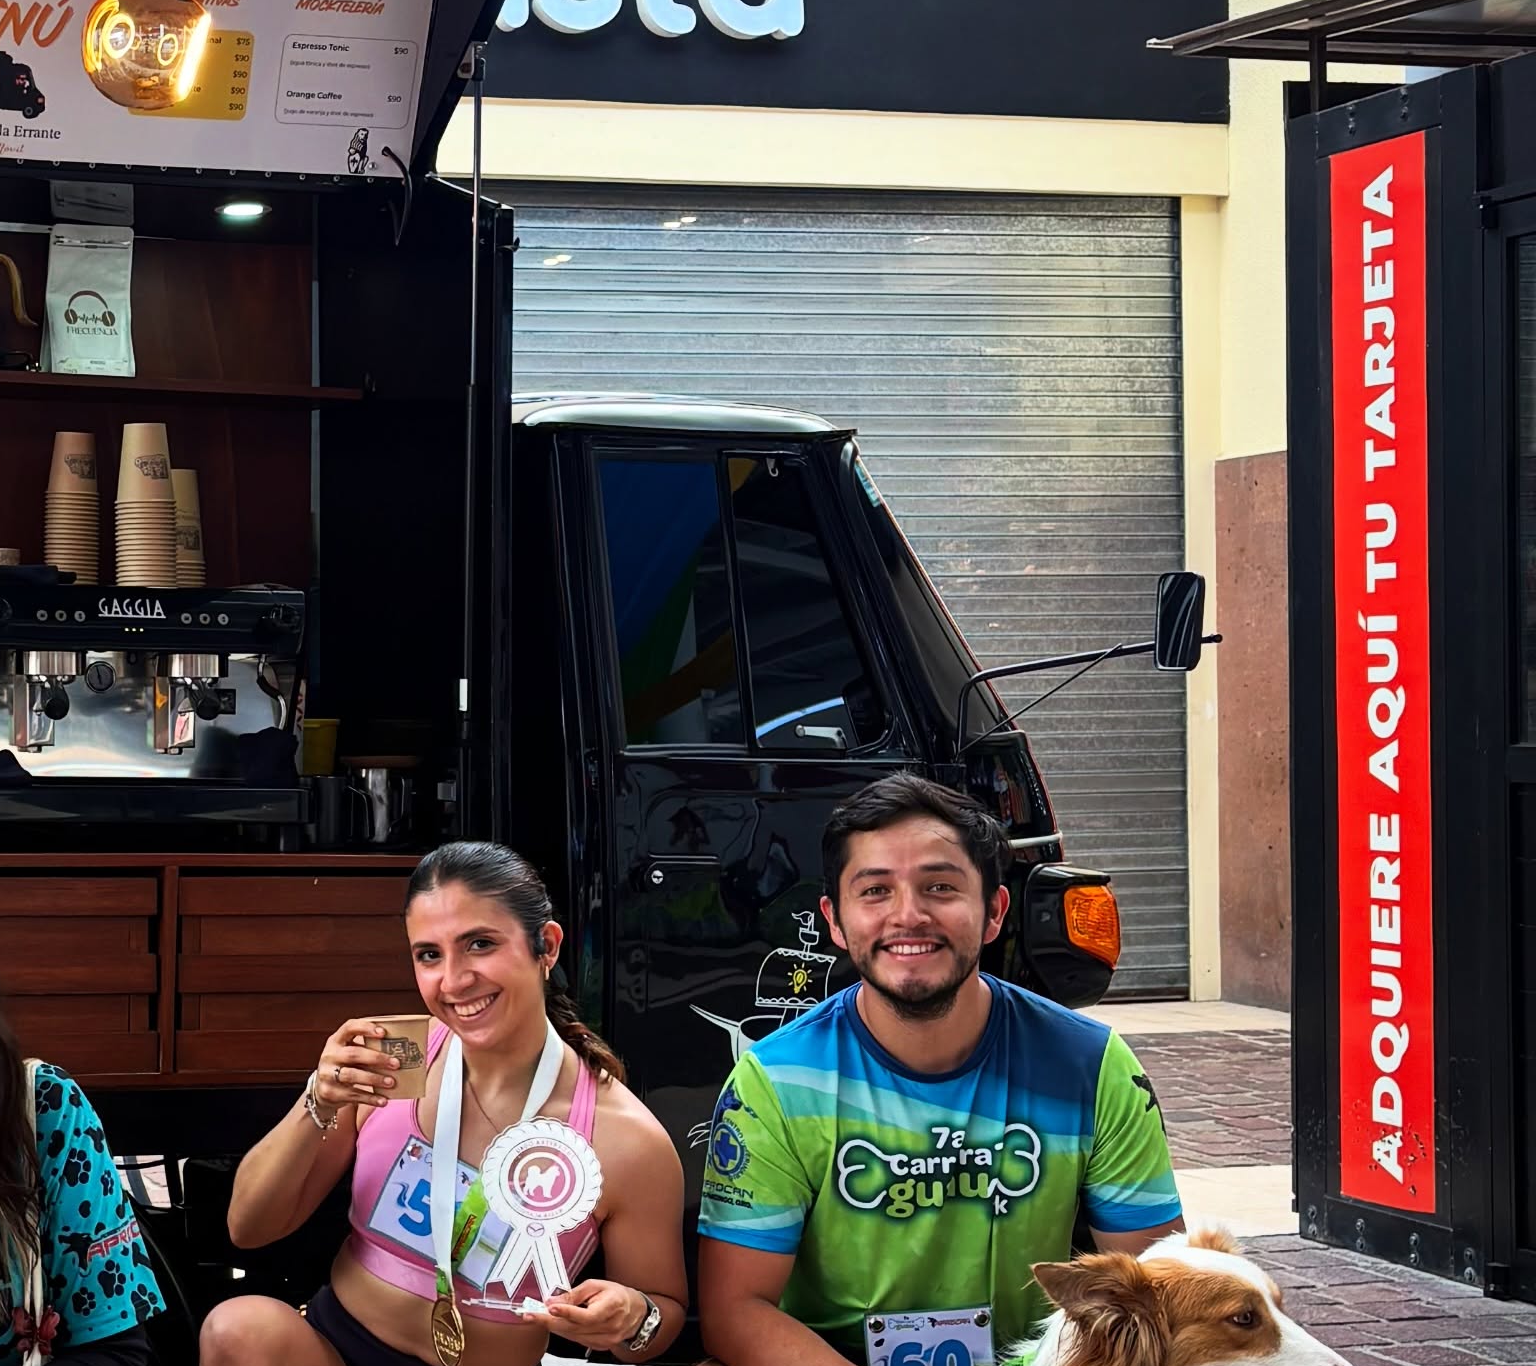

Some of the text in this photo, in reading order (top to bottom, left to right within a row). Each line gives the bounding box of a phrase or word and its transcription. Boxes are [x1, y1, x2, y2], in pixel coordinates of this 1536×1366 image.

[292, 42, 327, 51] Espresso
[286, 91, 315, 99] Orange
[14, 126, 61, 139] Errante
[98, 597, 166, 618] GAGGIA
[1358, 164, 1409, 1184] ADQUIERE AQUÍ TU TARJETA
[931, 1126, 966, 1150] 7a
